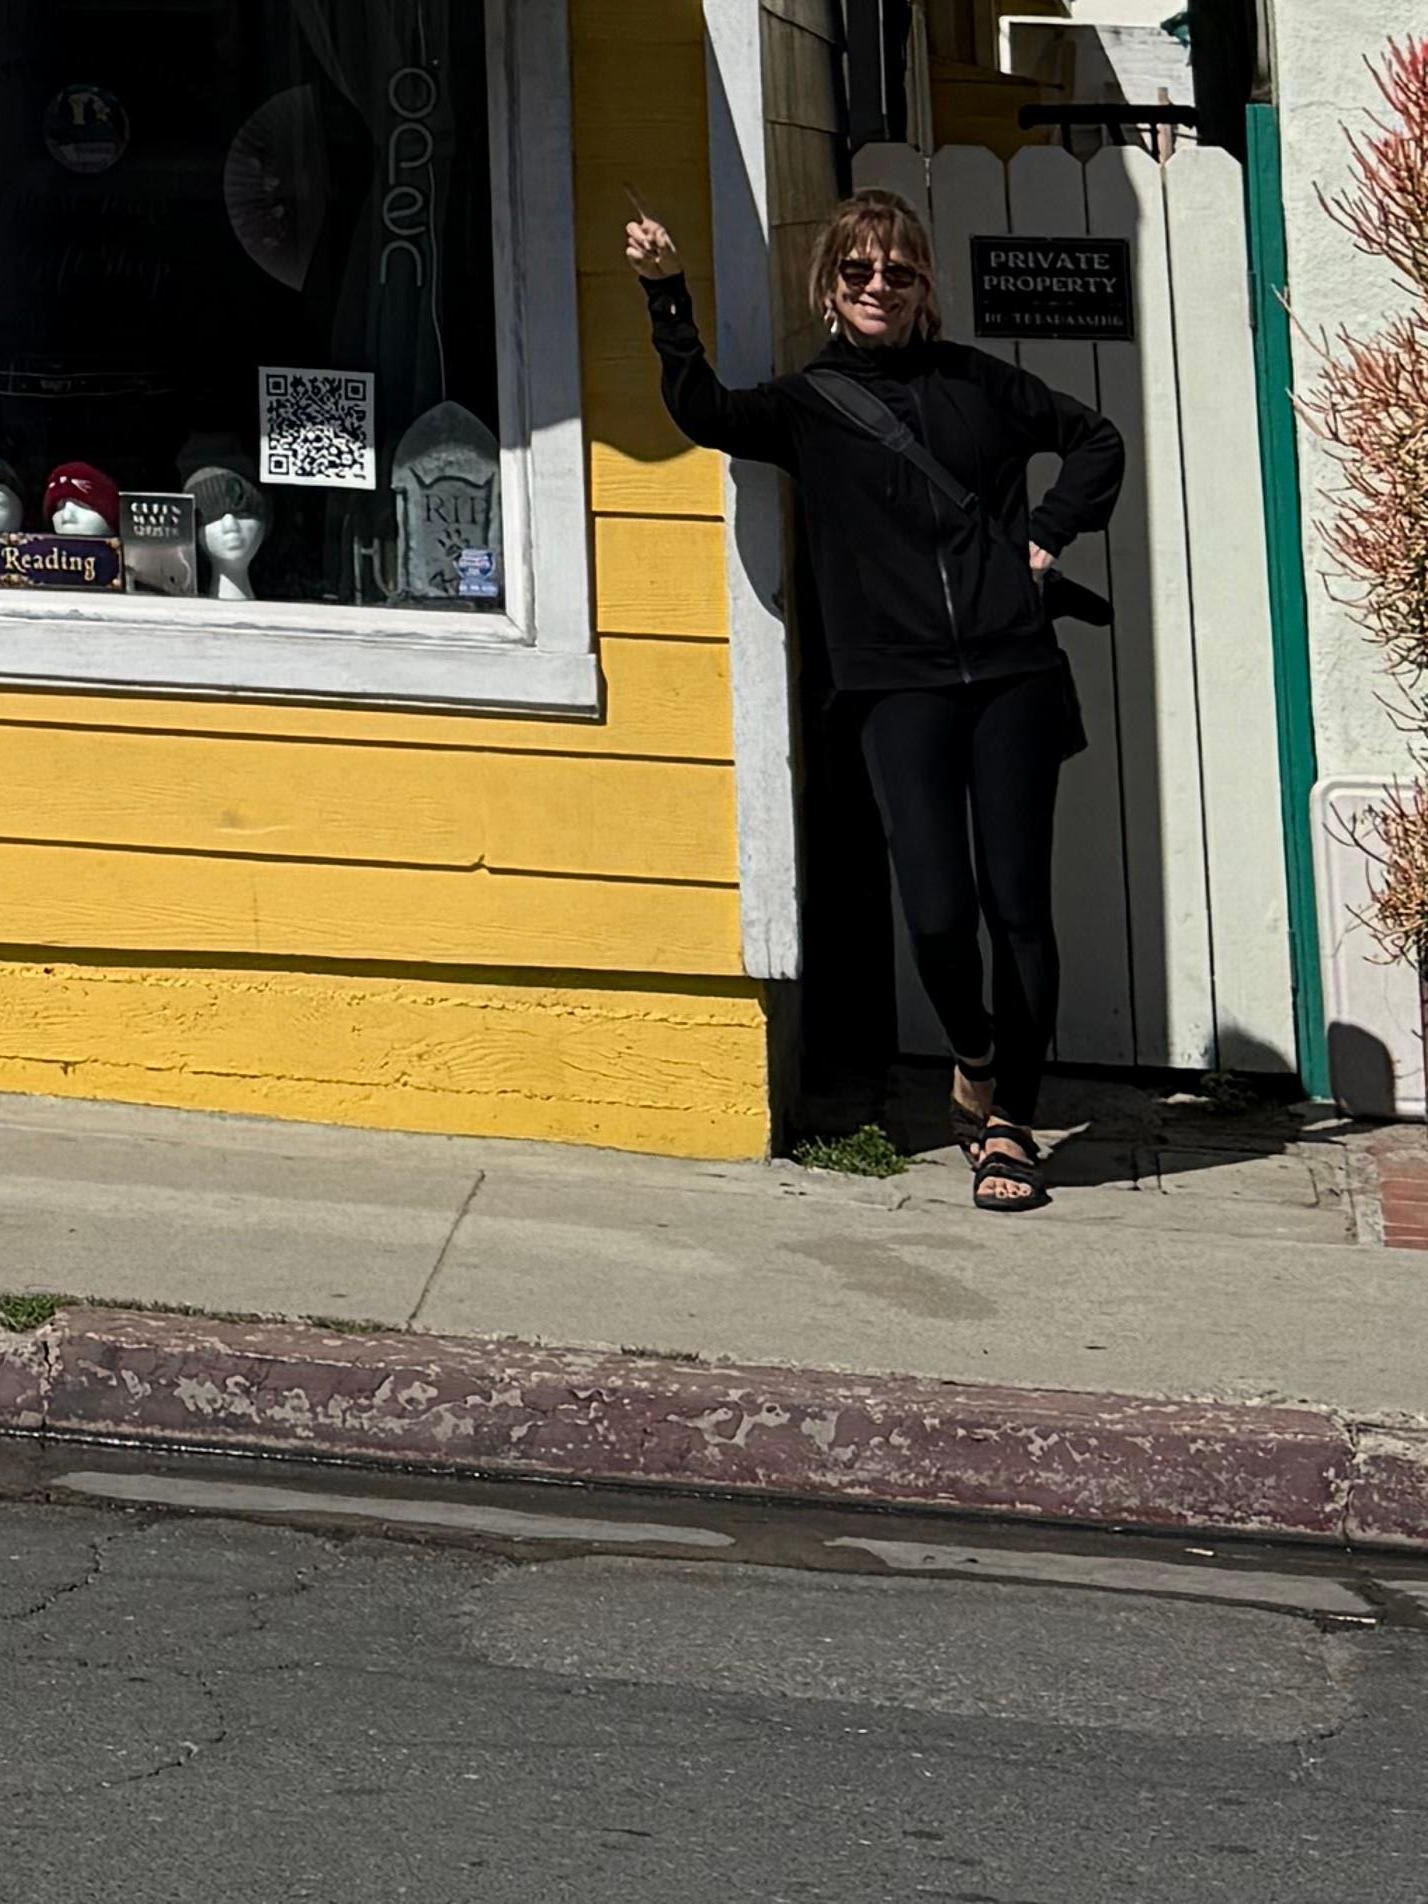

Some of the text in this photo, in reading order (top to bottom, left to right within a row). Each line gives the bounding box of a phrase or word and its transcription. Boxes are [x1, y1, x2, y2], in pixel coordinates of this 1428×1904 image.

[988, 250, 1111, 271] PRIVATE
[982, 274, 1119, 294] PROPERTY
[424, 494, 489, 525] RIP
[0, 545, 97, 582] Reading
